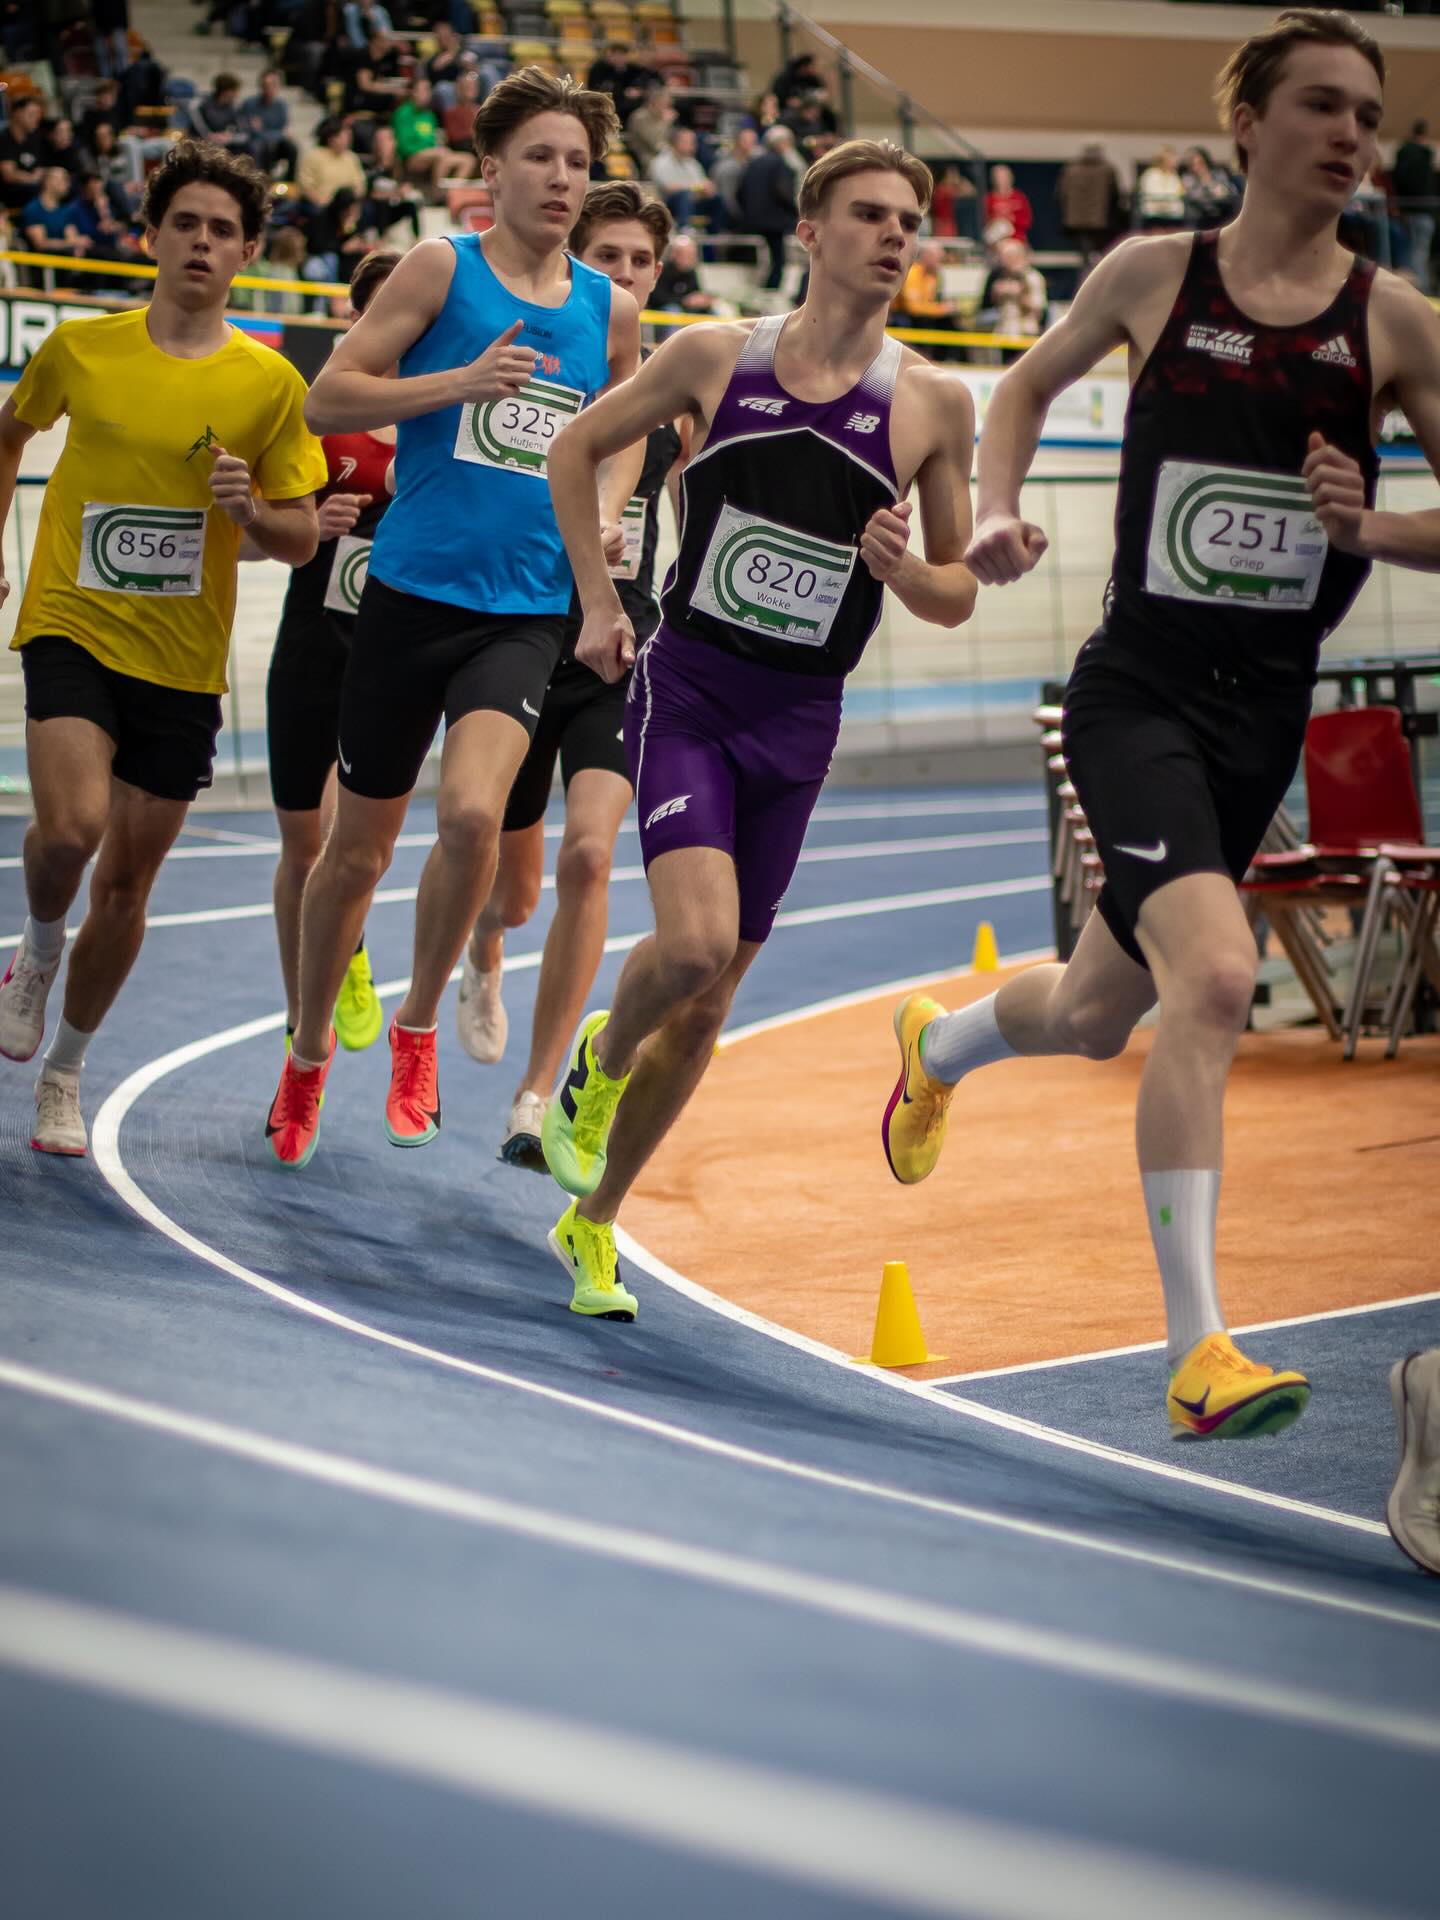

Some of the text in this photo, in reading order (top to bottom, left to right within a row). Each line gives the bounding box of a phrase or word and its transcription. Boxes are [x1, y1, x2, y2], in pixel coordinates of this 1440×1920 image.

[1187, 337, 1253, 358] BRABANT
[1312, 350, 1357, 367] adidas
[502, 403, 557, 438] 325
[1208, 508, 1289, 553] 251
[117, 530, 176, 558] 856
[1229, 555, 1265, 572] Griep
[747, 554, 817, 598] 820
[756, 591, 792, 610] Wokke
